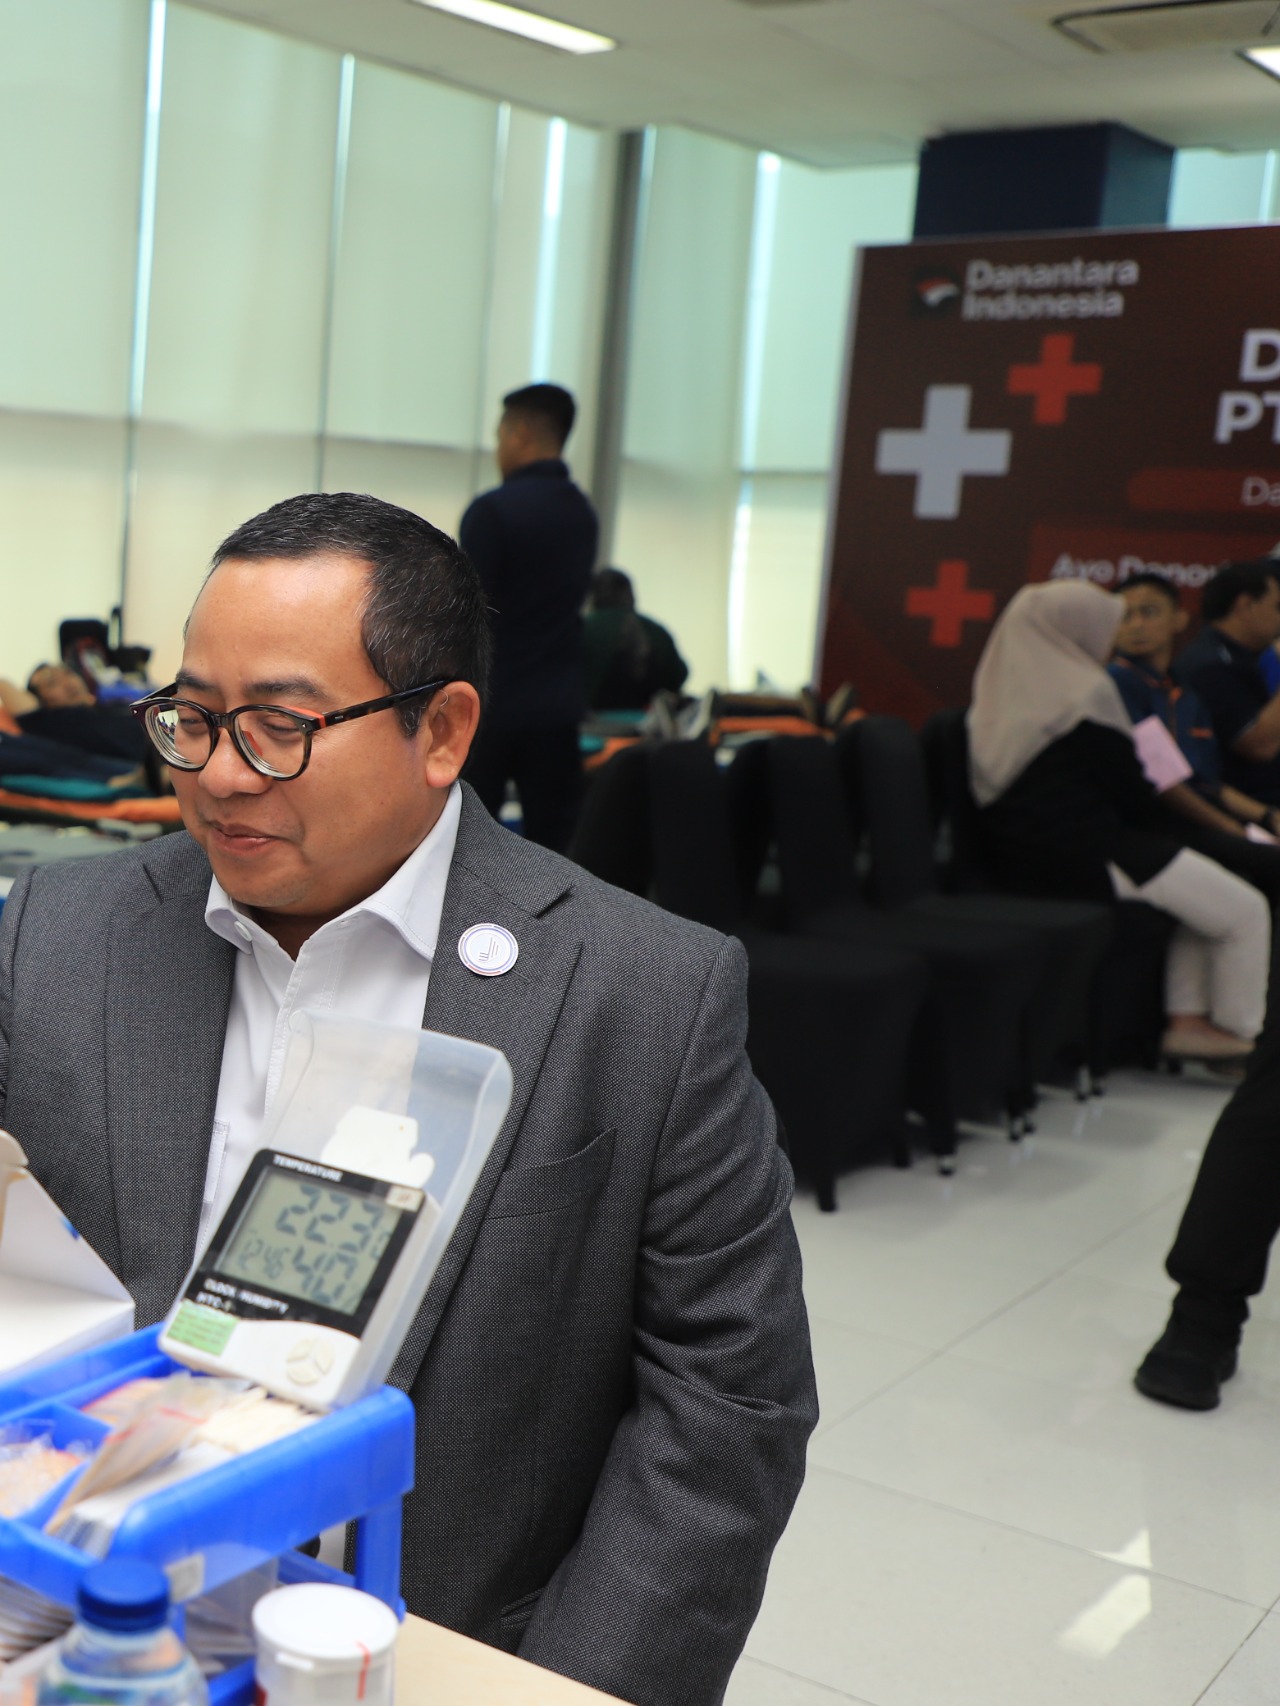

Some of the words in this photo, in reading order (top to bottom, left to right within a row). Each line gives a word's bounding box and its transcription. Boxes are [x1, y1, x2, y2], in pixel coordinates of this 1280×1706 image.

[966, 259, 1139, 289] Danantara
[963, 290, 1124, 320] Indonesia
[273, 1154, 343, 1182] TEMPERATURE
